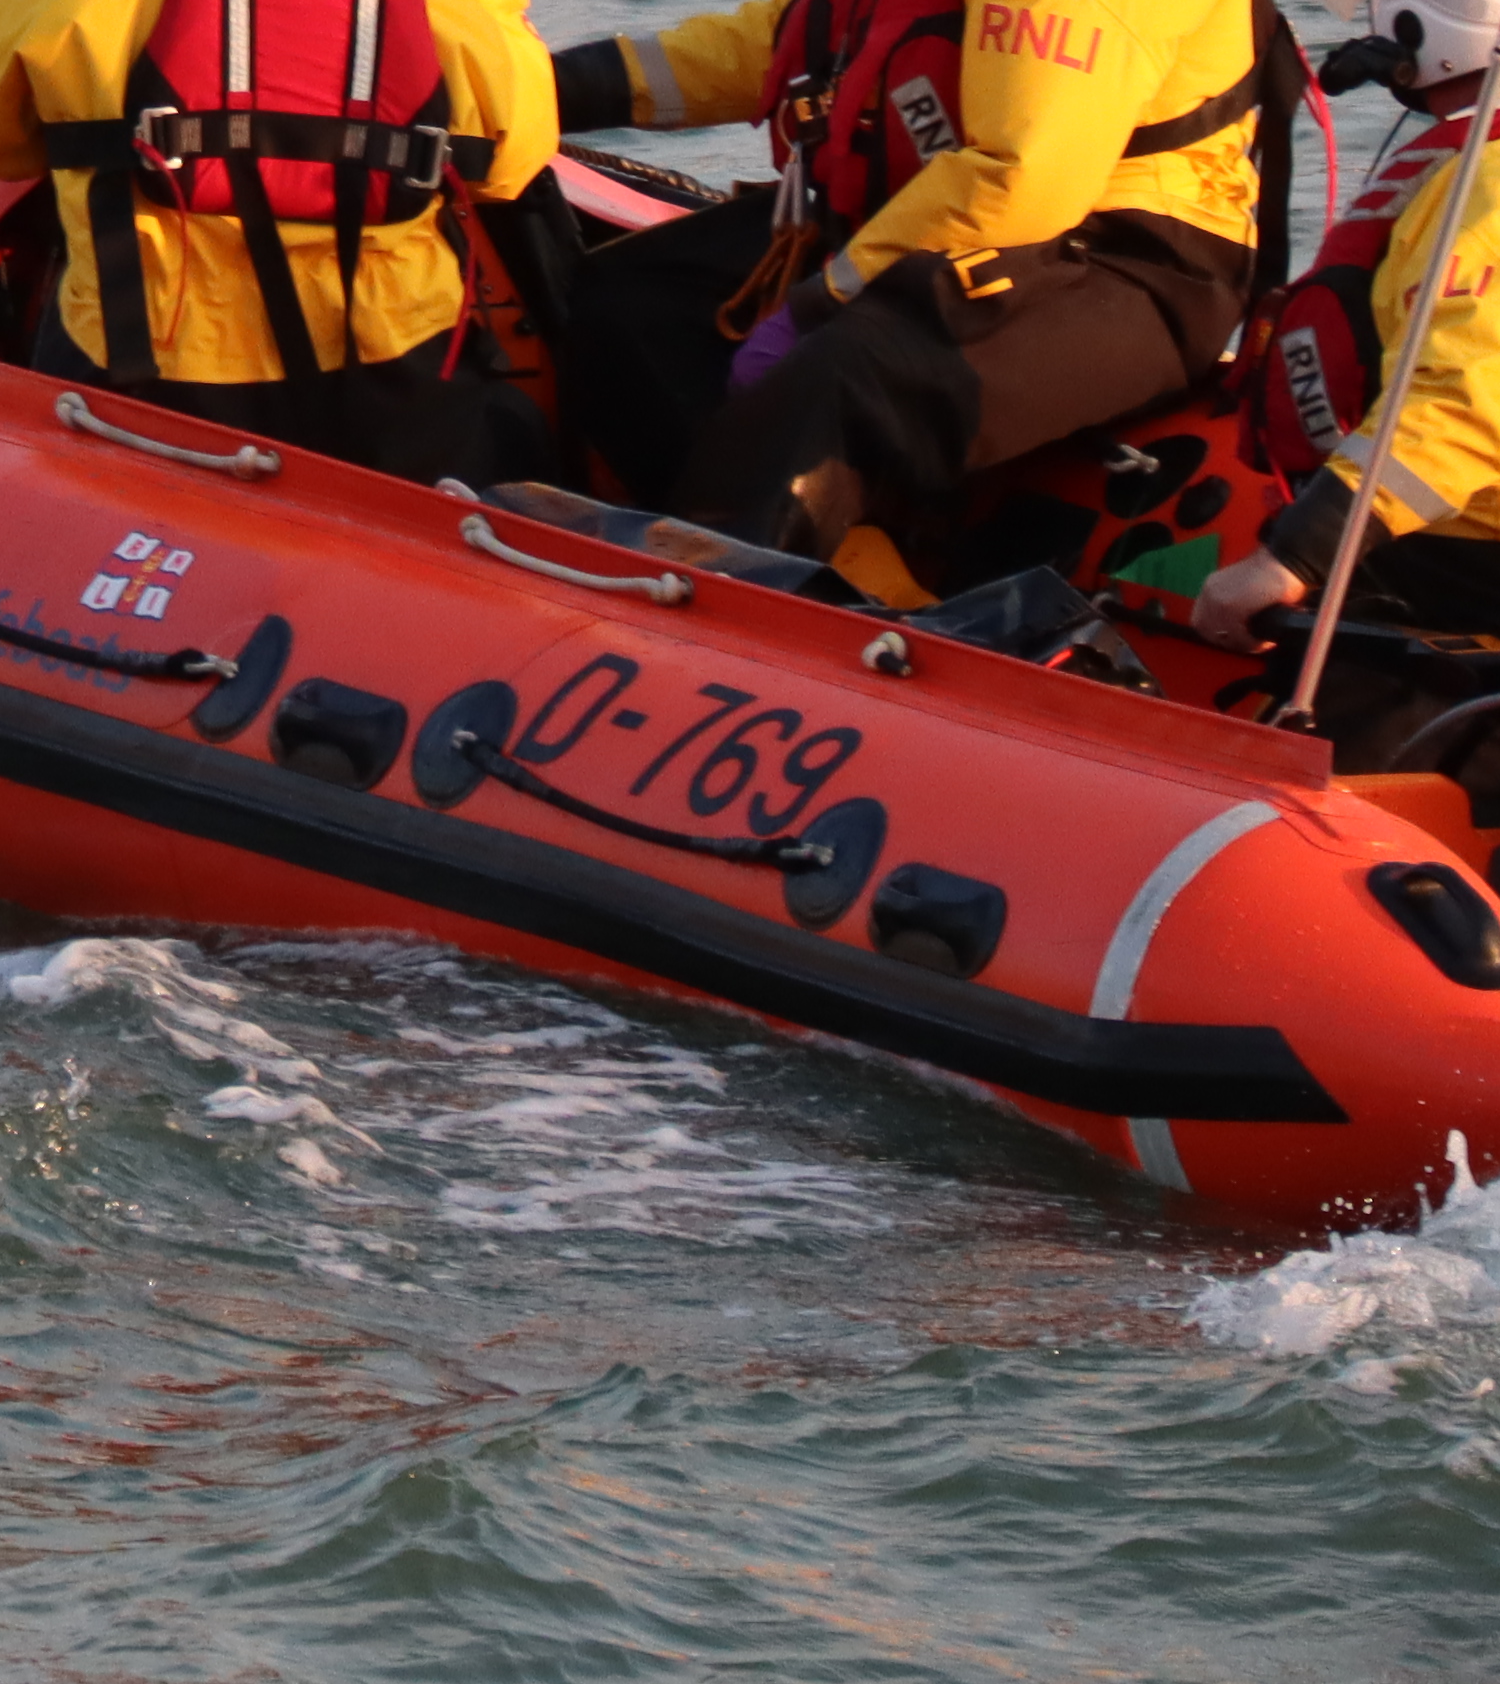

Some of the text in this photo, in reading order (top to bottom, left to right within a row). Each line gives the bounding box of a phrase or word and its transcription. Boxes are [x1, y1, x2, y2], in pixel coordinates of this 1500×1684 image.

[979, 3, 1103, 75] RNLI
[901, 95, 953, 155] RN
[953, 248, 1014, 301] LI
[1285, 344, 1336, 439] RNLI
[512, 652, 863, 836] D-769
